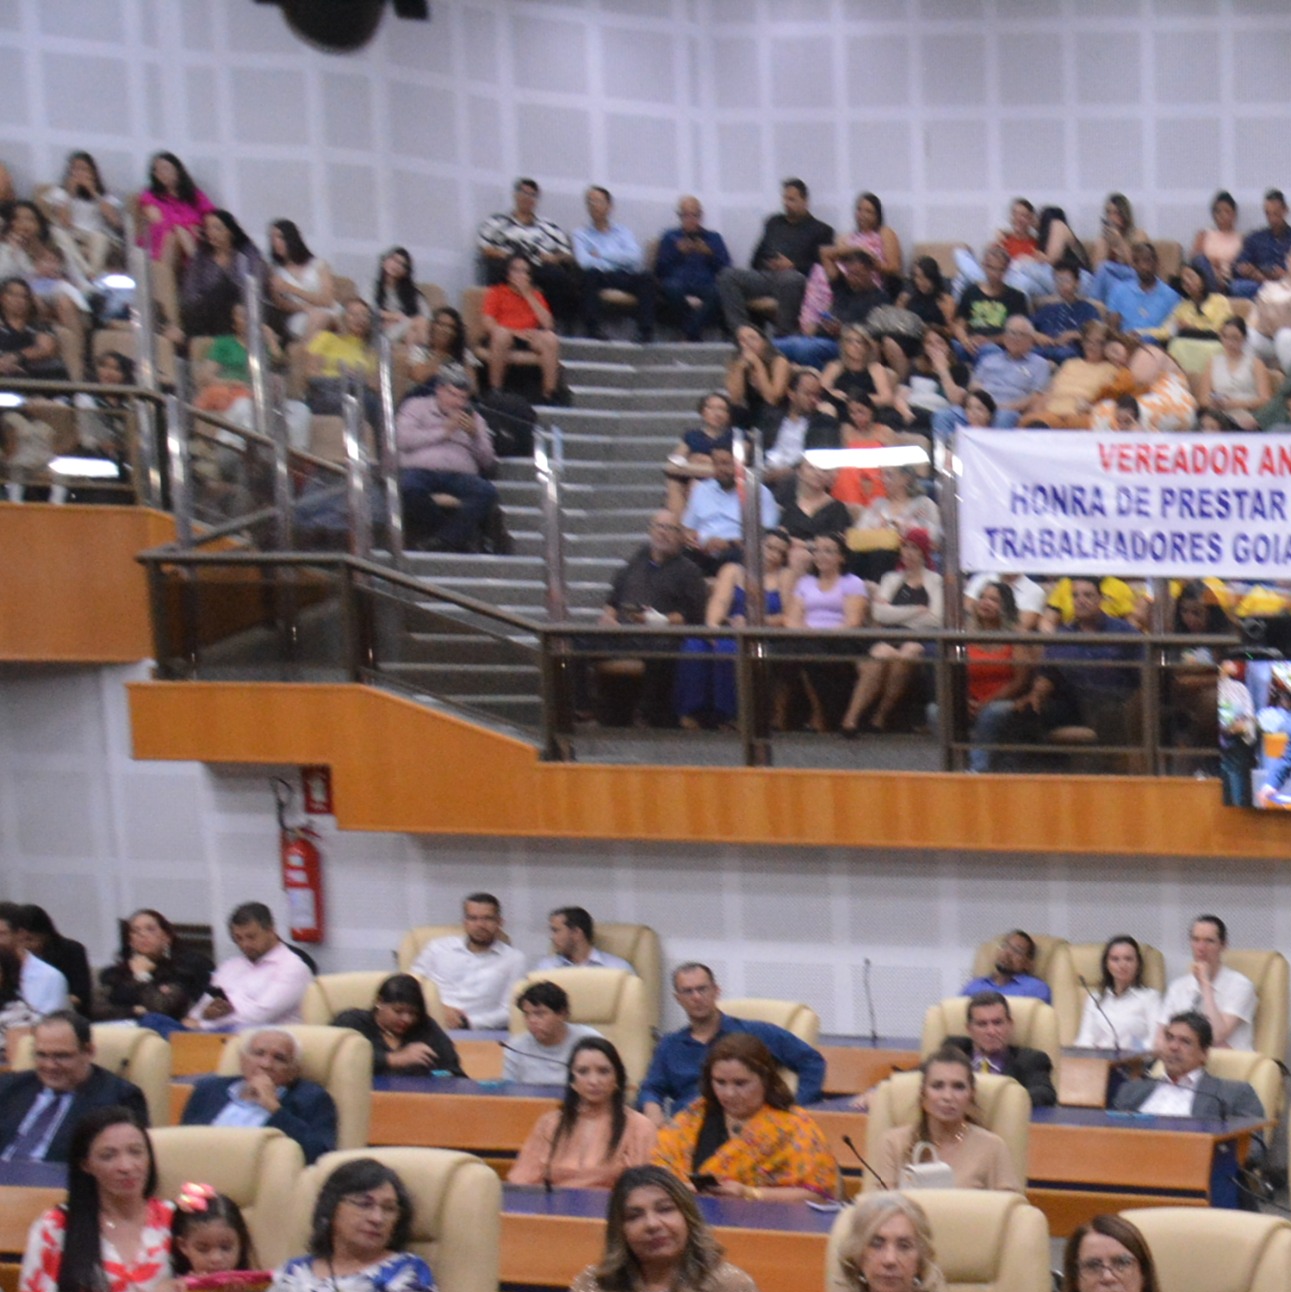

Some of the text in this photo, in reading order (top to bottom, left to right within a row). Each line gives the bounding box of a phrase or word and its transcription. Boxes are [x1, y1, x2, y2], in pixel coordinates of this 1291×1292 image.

[1098, 443, 1249, 475] VEREADOR
[1010, 484, 1106, 517] HONRA
[1116, 486, 1152, 517] DE
[1160, 487, 1287, 520] PRESTAR
[984, 526, 1223, 563] TRABALHADORES
